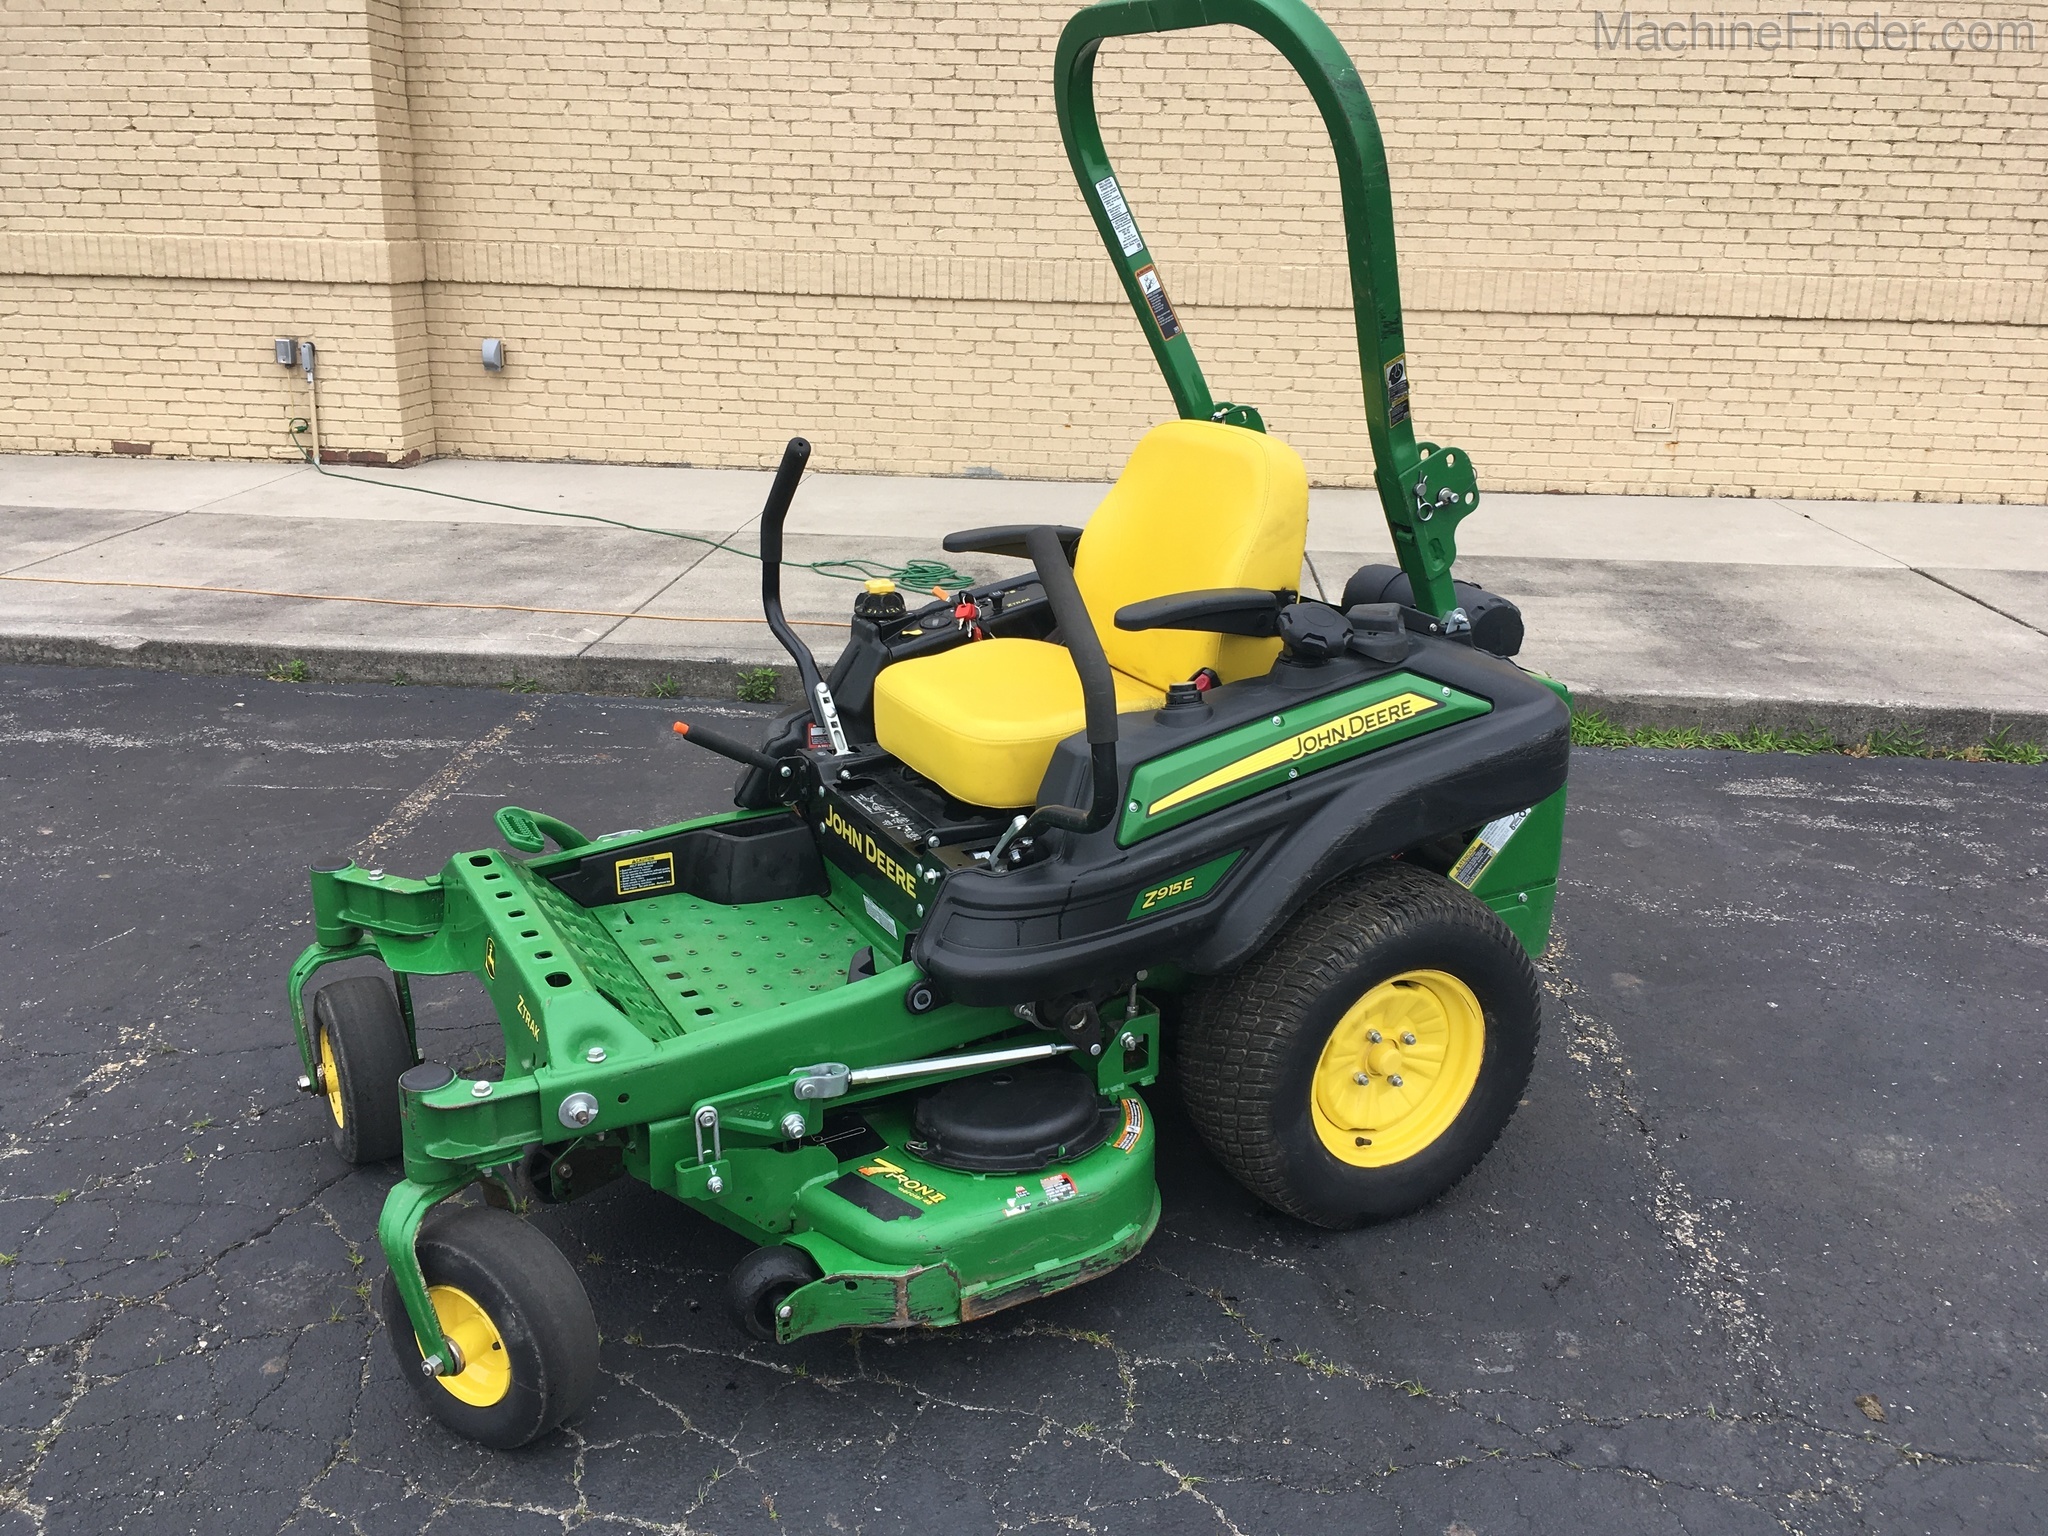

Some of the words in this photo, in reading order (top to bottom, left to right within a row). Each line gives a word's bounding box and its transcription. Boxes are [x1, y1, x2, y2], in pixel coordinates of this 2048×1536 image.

[1292, 724, 1346, 758] JOHN
[1349, 700, 1413, 735] DEERE
[825, 804, 863, 854] JOHN
[865, 834, 917, 899] DEERE
[1142, 876, 1195, 909] Z915E
[516, 994, 540, 1042] ZTRAK
